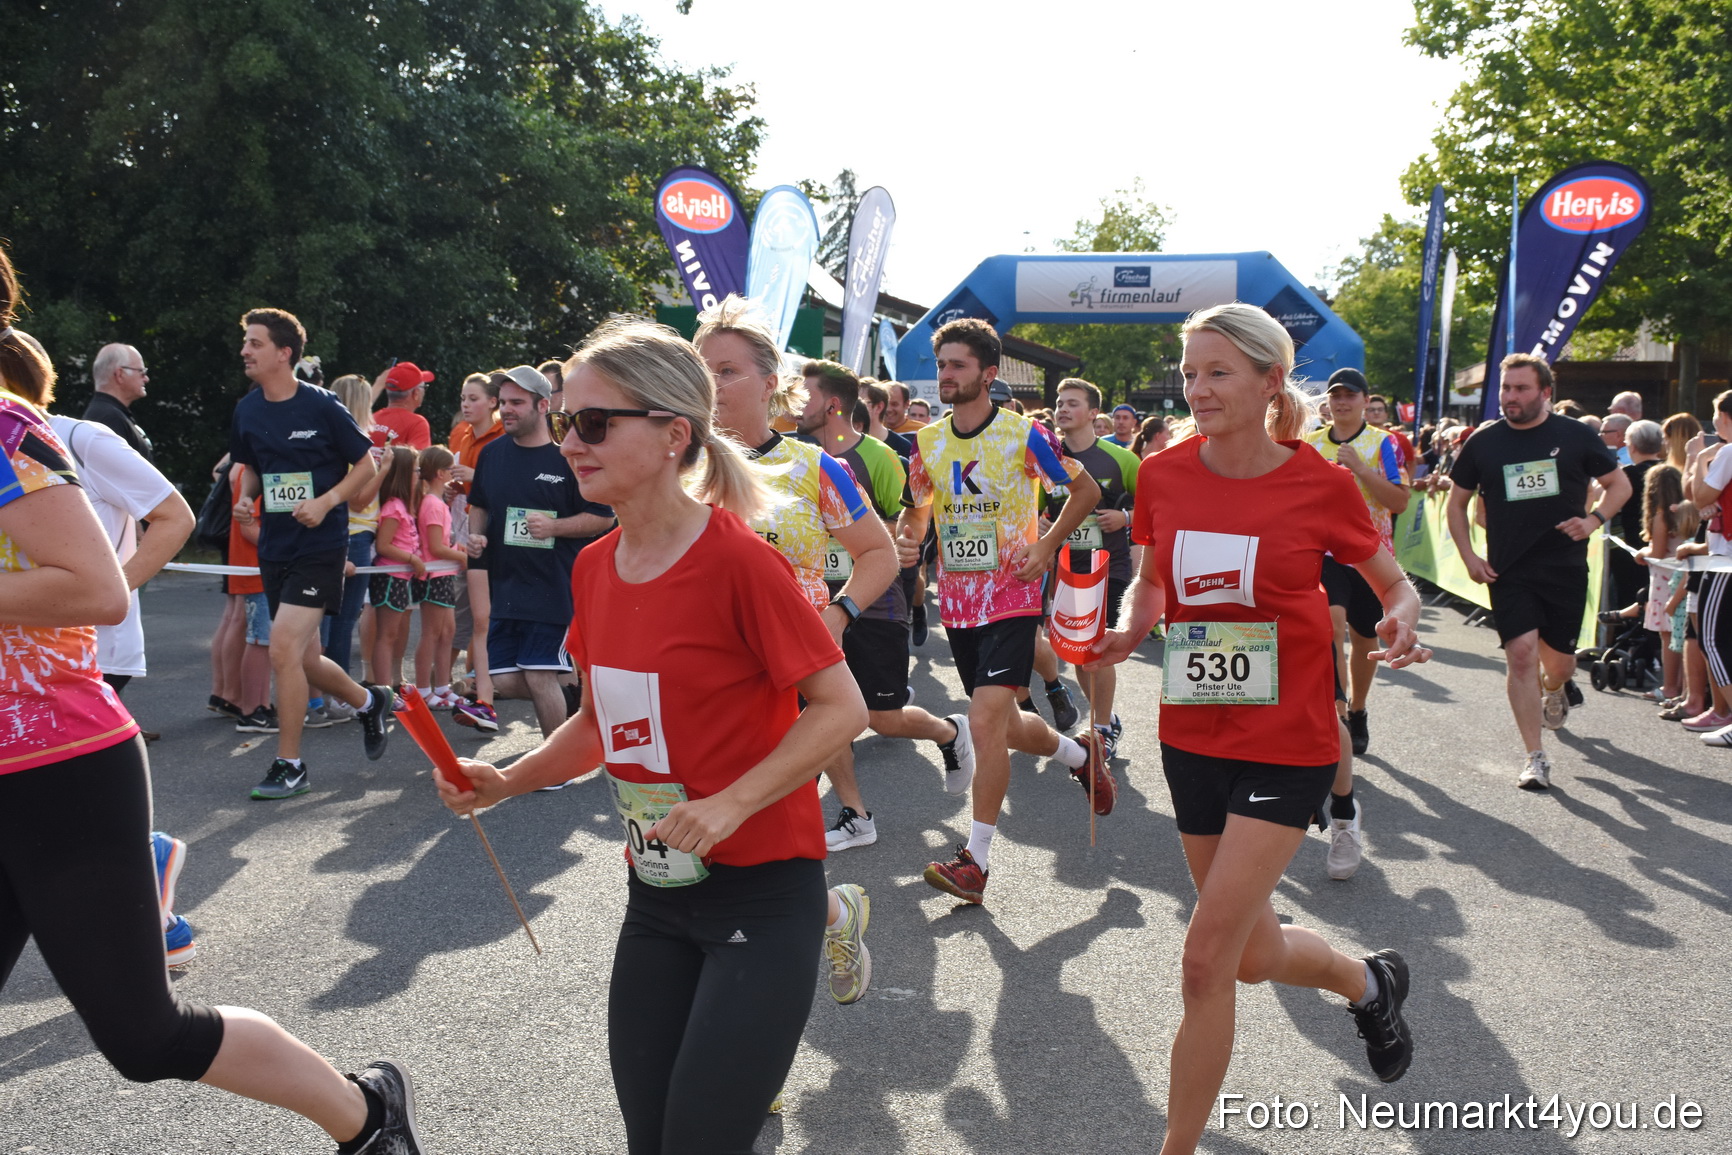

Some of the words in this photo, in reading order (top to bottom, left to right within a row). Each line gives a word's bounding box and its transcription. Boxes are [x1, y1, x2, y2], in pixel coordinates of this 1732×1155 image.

[1551, 191, 1634, 220] Hervis
[1100, 288, 1182, 304] firmenlauf
[952, 460, 983, 495] K
[1516, 474, 1547, 490] 435
[270, 486, 307, 501] 1402
[943, 502, 1001, 513] KÜFNER
[511, 521, 529, 536] 13
[947, 539, 989, 558] 1320
[1200, 577, 1225, 589] DEHN
[1065, 617, 1089, 627] DEHN
[1180, 638, 1222, 647] firmenlauf
[1186, 652, 1250, 682] 530
[624, 728, 640, 741] DEHN
[639, 856, 670, 870] Corinna
